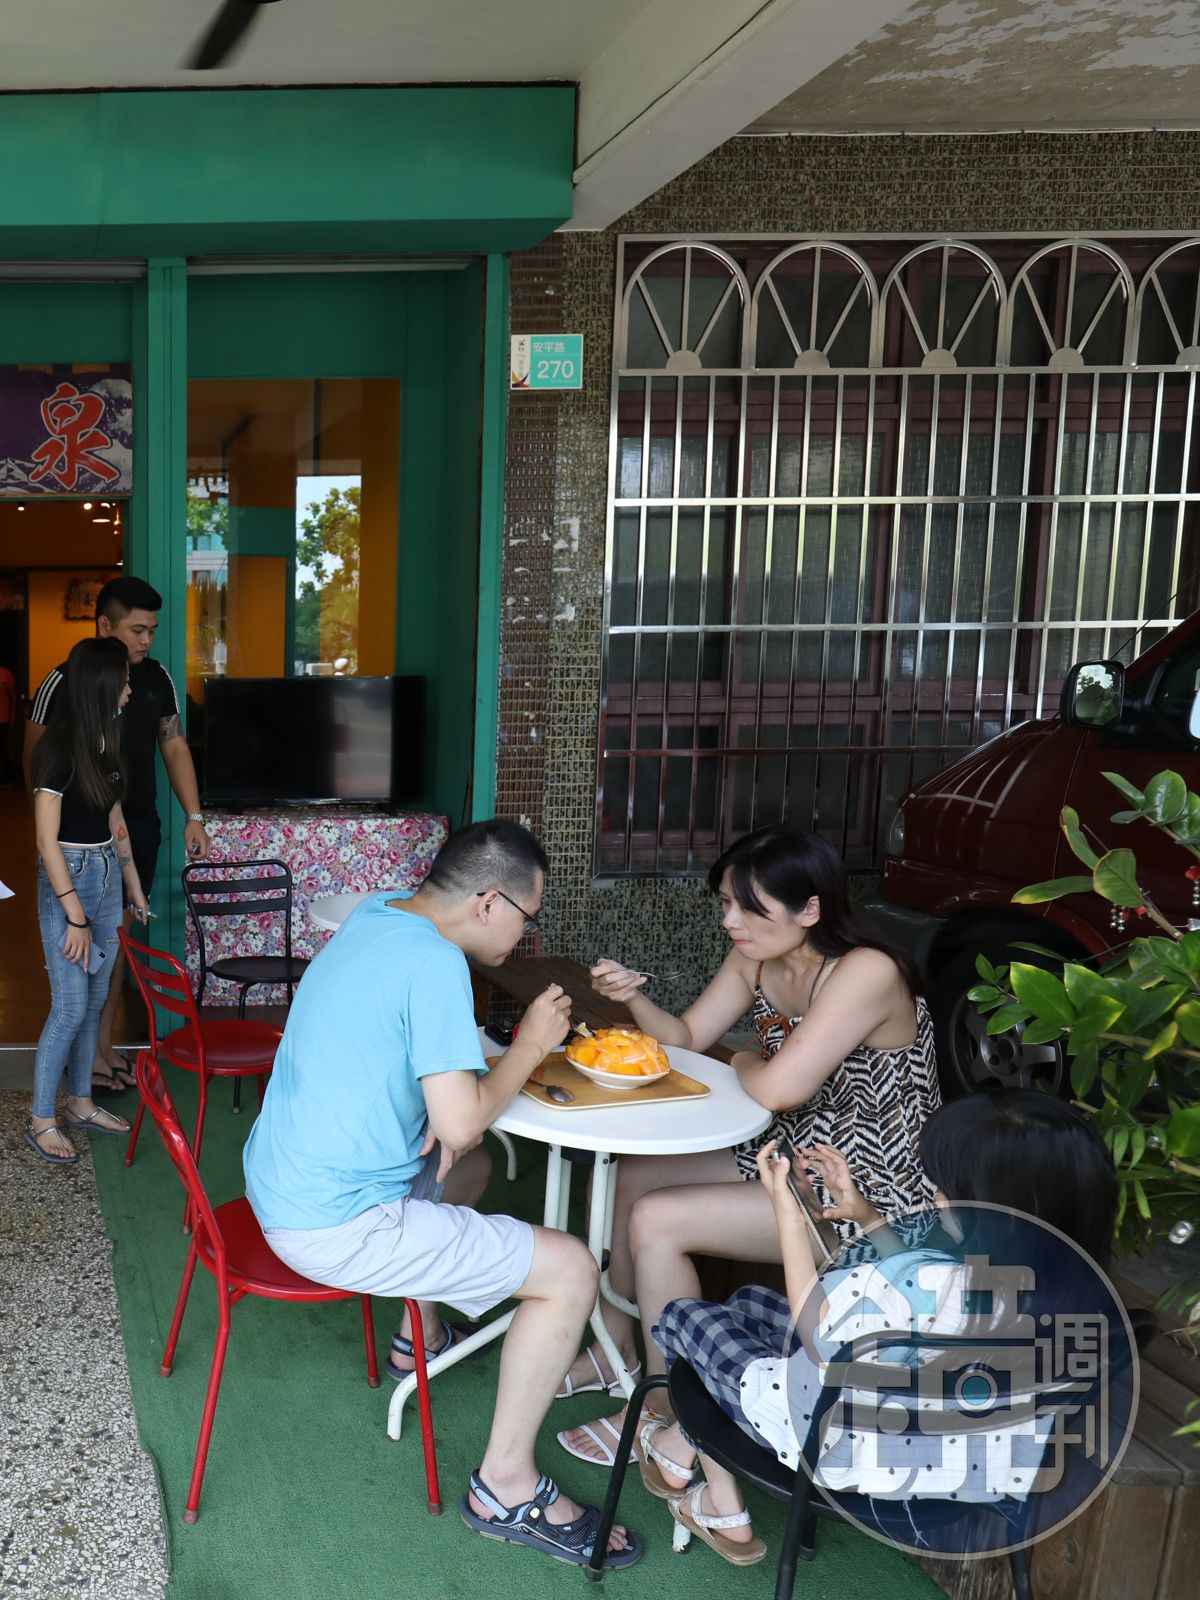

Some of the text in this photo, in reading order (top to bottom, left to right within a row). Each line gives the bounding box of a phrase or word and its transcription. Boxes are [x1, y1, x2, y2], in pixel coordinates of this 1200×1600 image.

[533, 341, 565, 353] 安平路
[537, 359, 574, 379] 270
